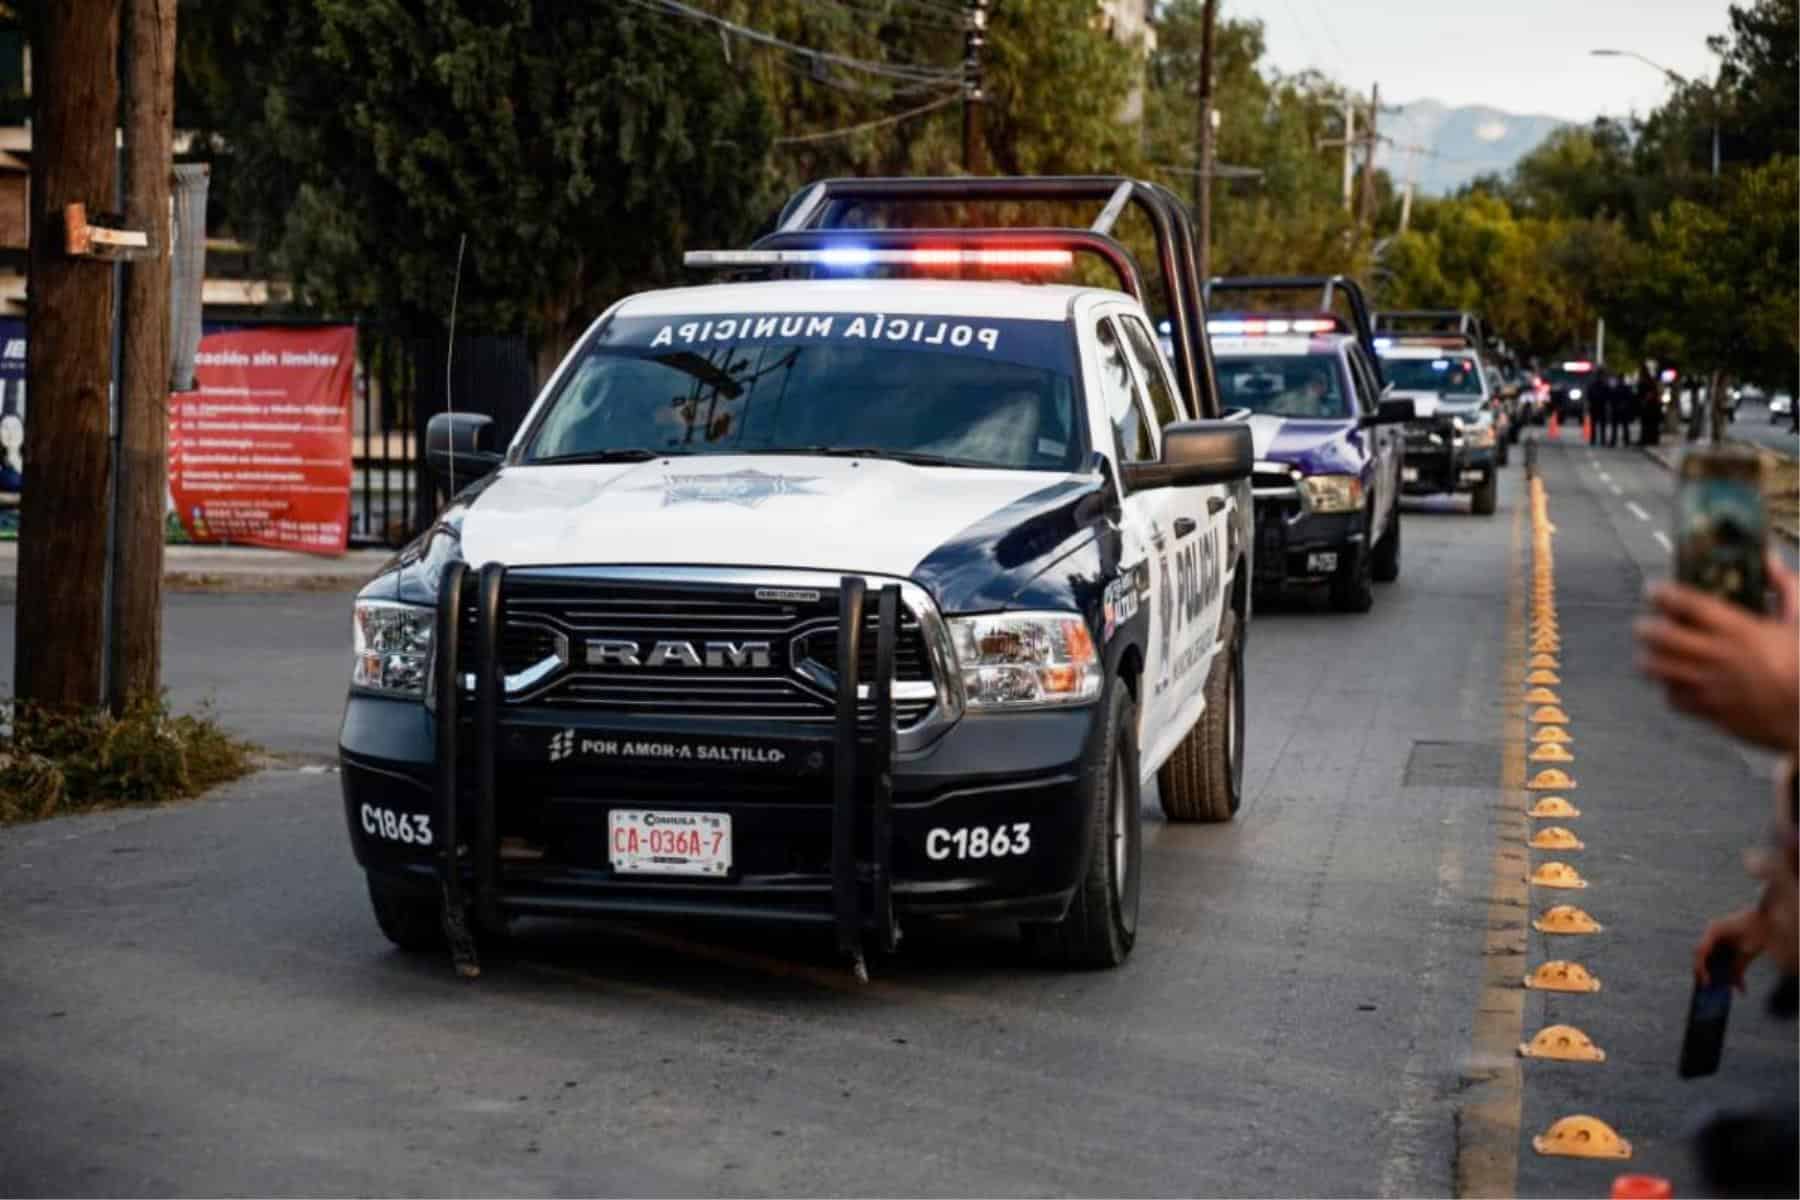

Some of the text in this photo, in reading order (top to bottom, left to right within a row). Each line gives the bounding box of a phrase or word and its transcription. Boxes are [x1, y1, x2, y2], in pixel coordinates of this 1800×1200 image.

[585, 639, 770, 667] RAM
[581, 739, 780, 763] POR AMOR A SALTILLO
[361, 803, 433, 845] C1863
[614, 827, 724, 857] CA-036A-7
[926, 822, 1031, 859] C1863
